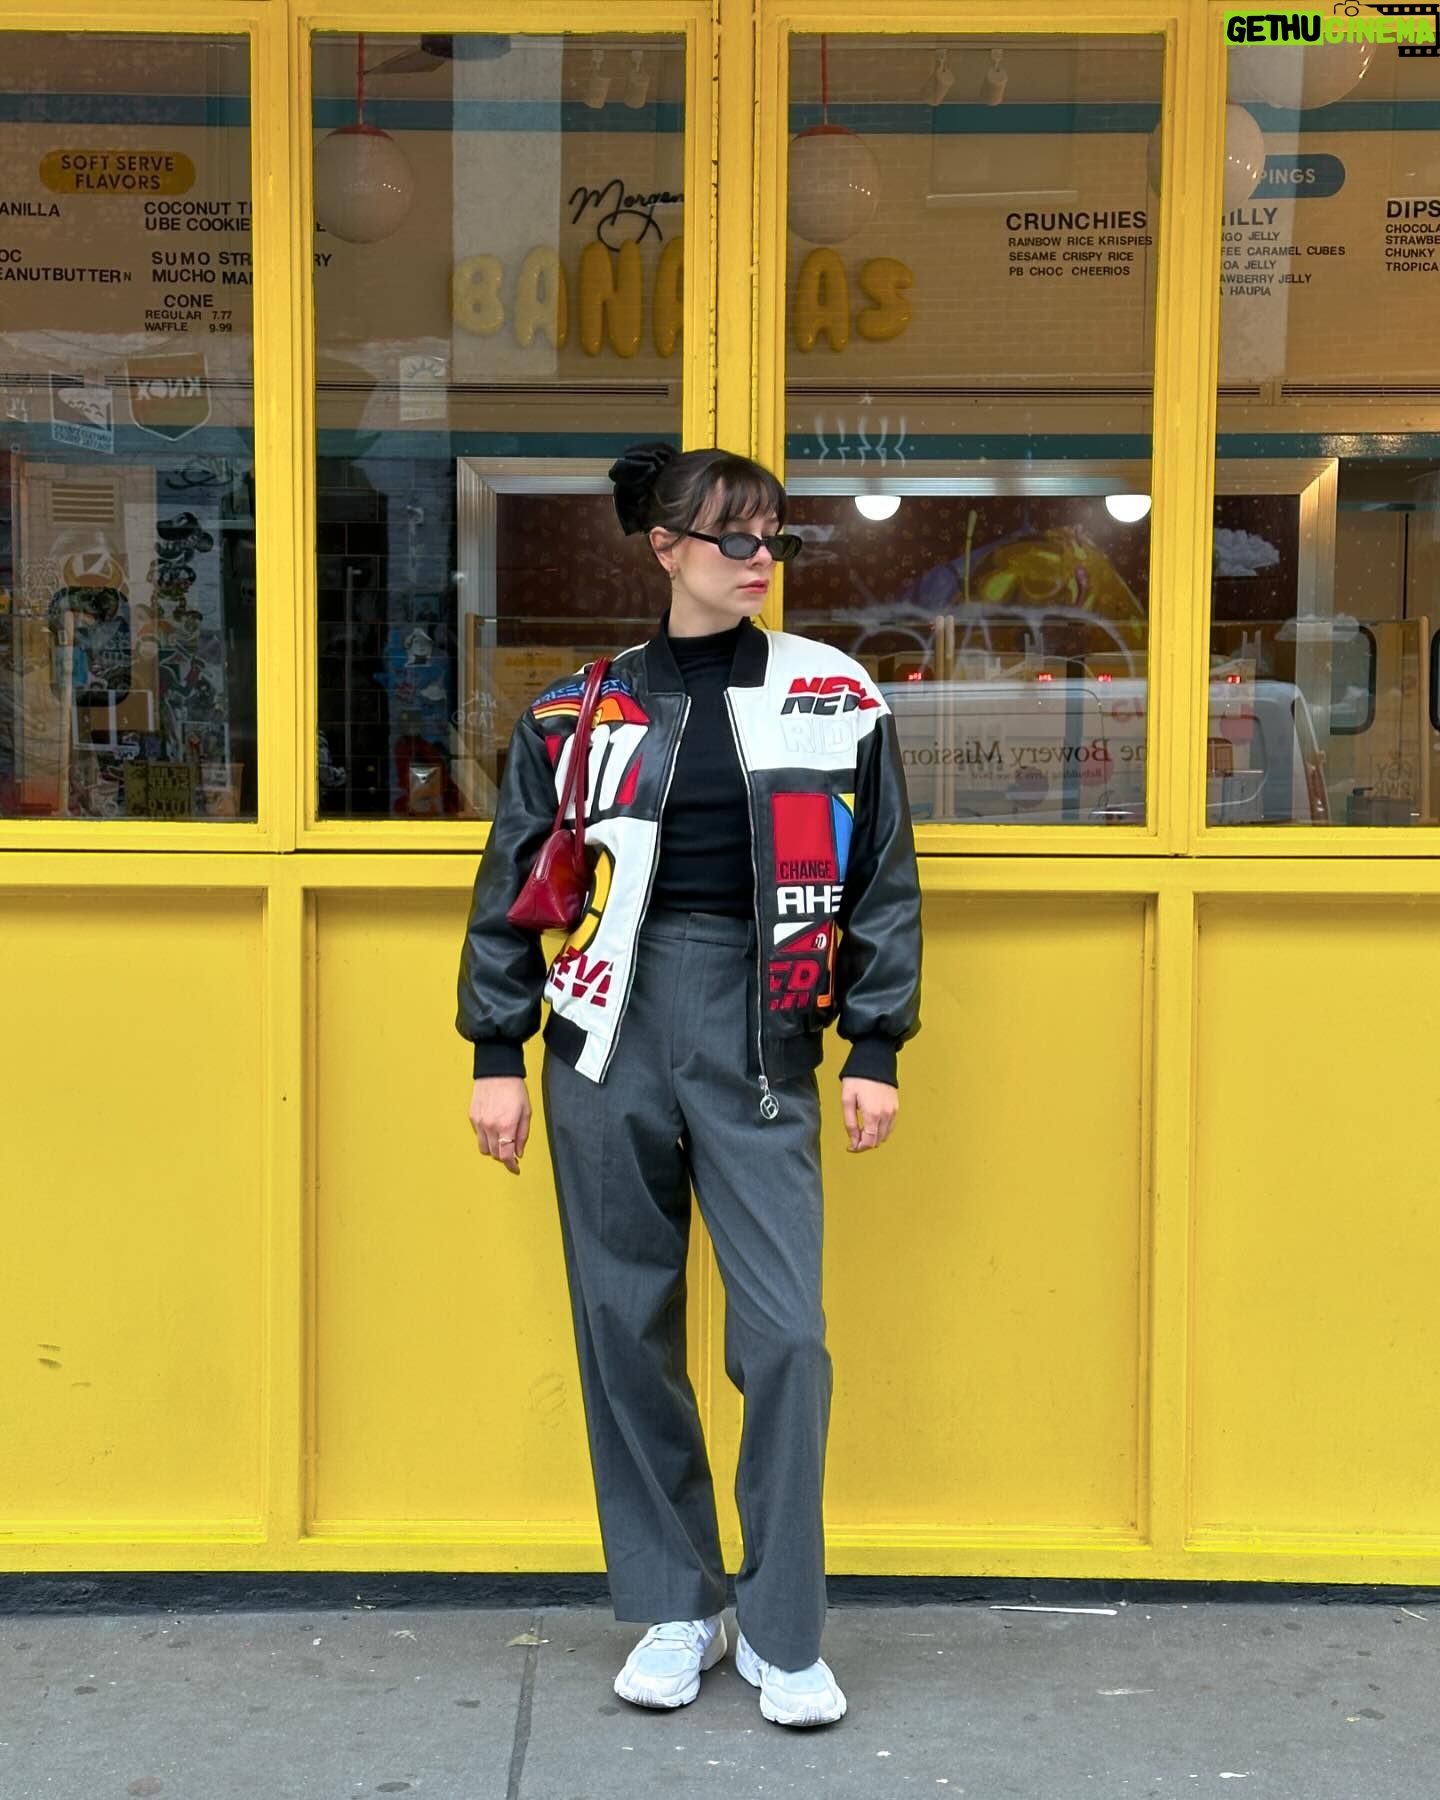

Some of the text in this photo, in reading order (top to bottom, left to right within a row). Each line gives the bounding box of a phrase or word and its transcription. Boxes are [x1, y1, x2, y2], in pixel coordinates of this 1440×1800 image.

[61, 155, 174, 171] SOFT SERVE
[76, 174, 161, 190] FLAVORS
[144, 201, 231, 215] COCONUT
[1387, 200, 1440, 218] DIPS
[1006, 211, 1147, 231] CRUNCHIES
[1221, 207, 1278, 226] ILLY
[145, 217, 250, 231] UBE COOKIE
[1008, 235, 1153, 247] RAINBOW RICE KRISPIES
[1248, 231, 1280, 241] JELLY
[1009, 251, 1134, 261] SESAME CRISPY RICE
[1247, 246, 1301, 256] CARAMEL
[1306, 246, 1346, 256] CUBES
[1385, 247, 1435, 258] CHUNKY
[151, 251, 210, 265] SUMO
[1009, 266, 1130, 277] PB CHOC CHEERIOS
[1244, 260, 1277, 270] JELLY
[152, 268, 216, 283] MUCHO
[1278, 274, 1312, 284] JELLY
[1230, 286, 1271, 296] HAUPIA
[164, 294, 214, 308] CONE
[145, 310, 232, 320] REGULAR 7.77
[144, 322, 232, 333] WAFFLE 9.99
[780, 860, 832, 880] CHANGE
